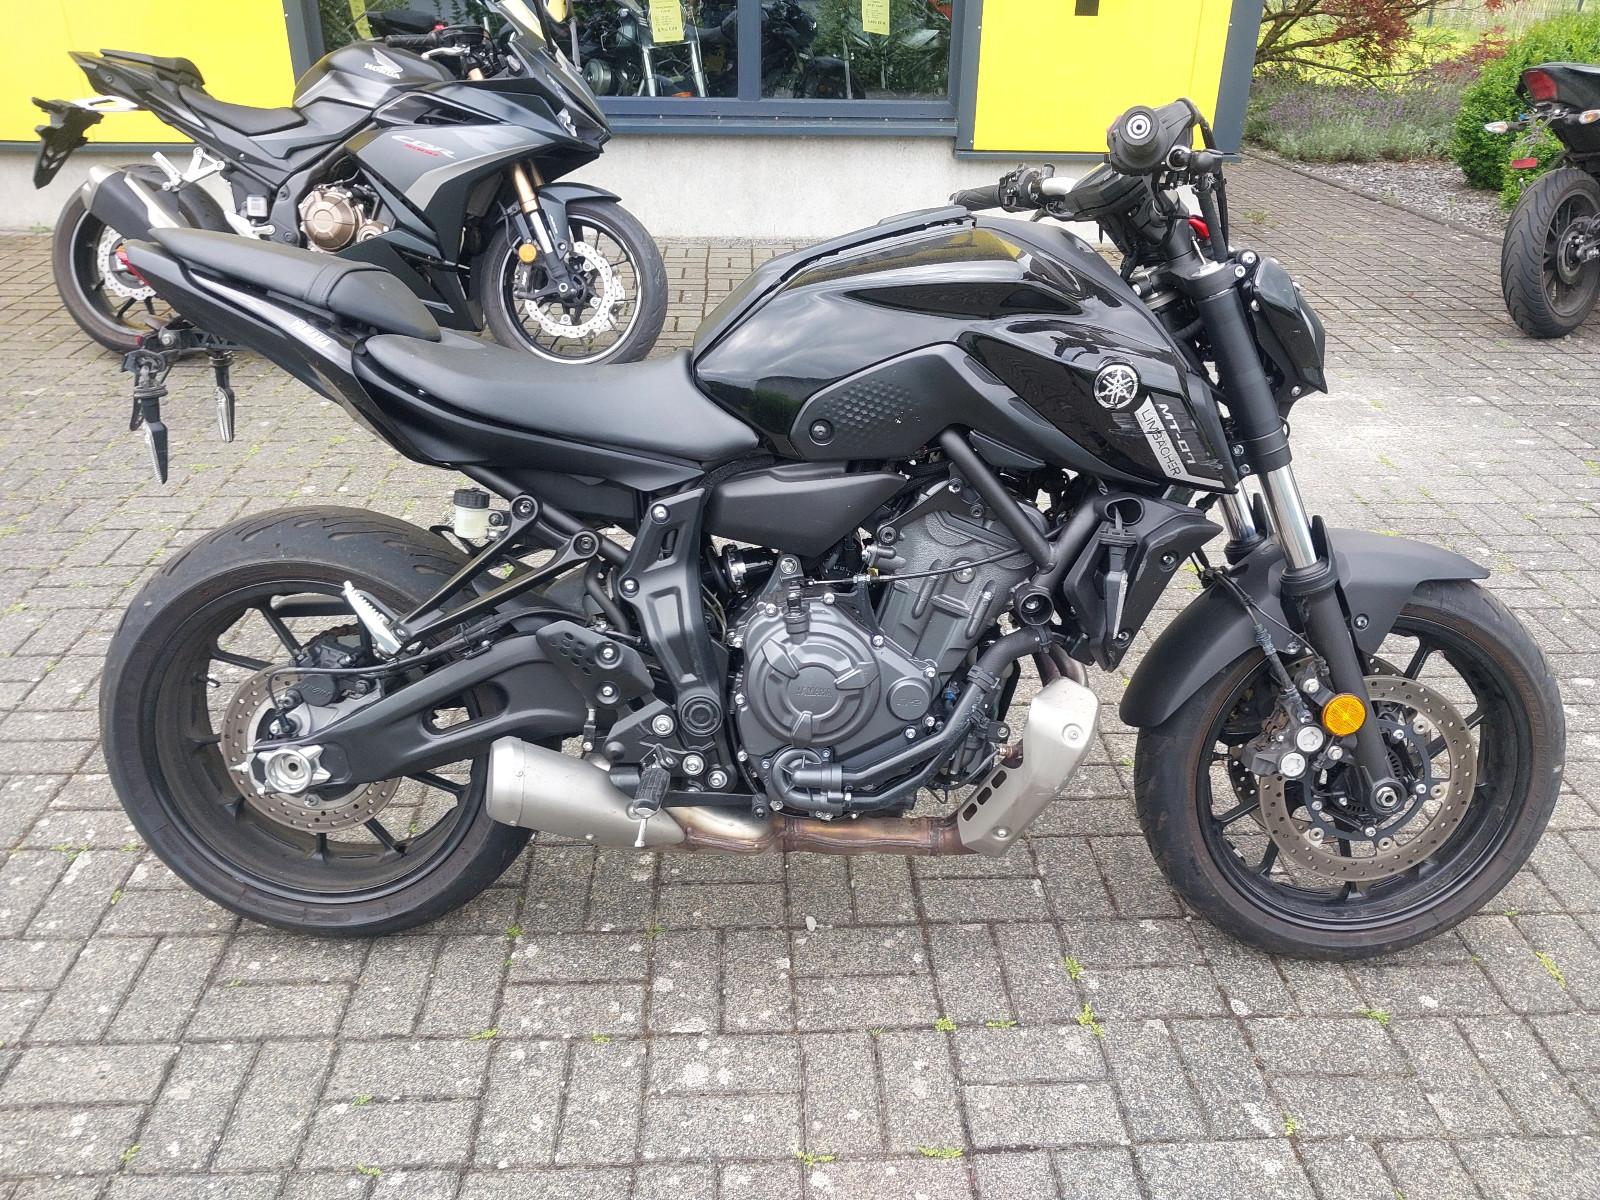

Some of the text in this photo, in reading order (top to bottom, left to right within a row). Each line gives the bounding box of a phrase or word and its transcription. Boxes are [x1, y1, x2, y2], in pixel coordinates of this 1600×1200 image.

[364, 63, 400, 79] HONDA
[1141, 409, 1181, 476] LIMBACHER
[1156, 403, 1197, 464] MT-07
